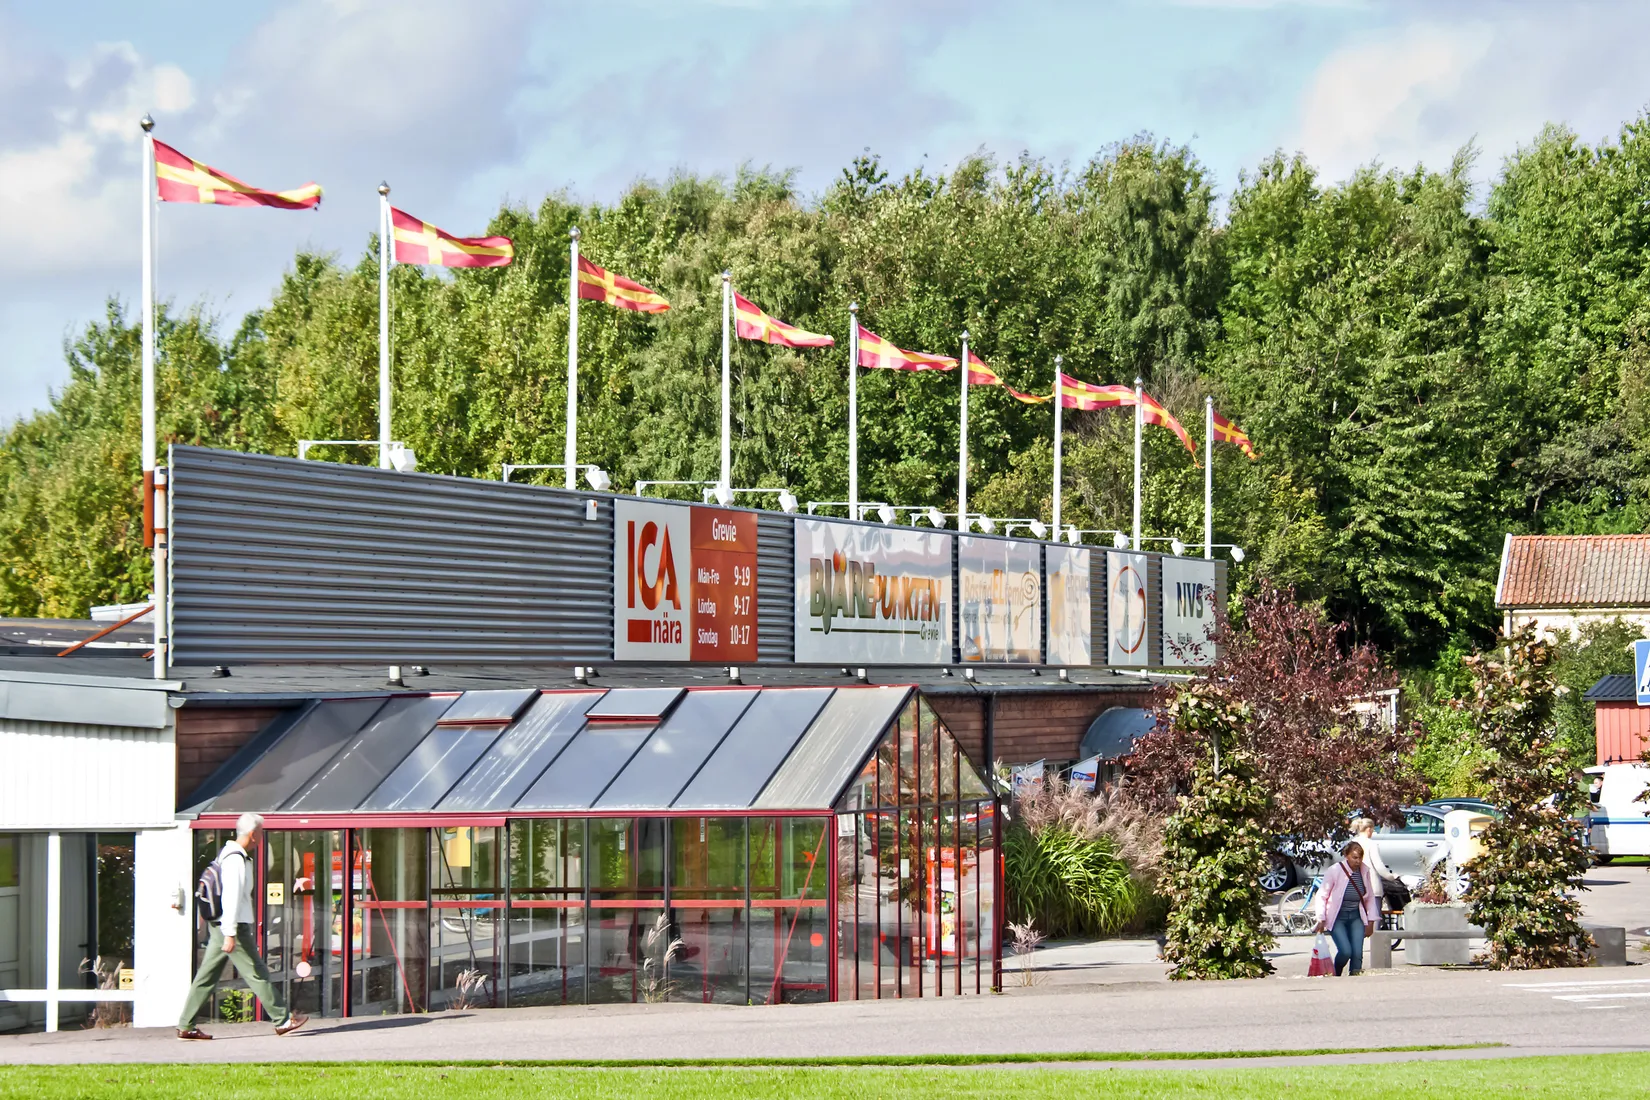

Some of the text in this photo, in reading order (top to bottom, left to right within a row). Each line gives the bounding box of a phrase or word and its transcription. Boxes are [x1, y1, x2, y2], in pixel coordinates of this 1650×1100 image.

[712, 517, 737, 542] Grevie
[627, 520, 682, 611] ICA
[733, 565, 751, 586] 9-19
[697, 595, 750, 618] Lördag 9-17
[1176, 581, 1204, 619] NVS
[653, 611, 682, 644] nära
[697, 624, 751, 648] Söndag 10-17
